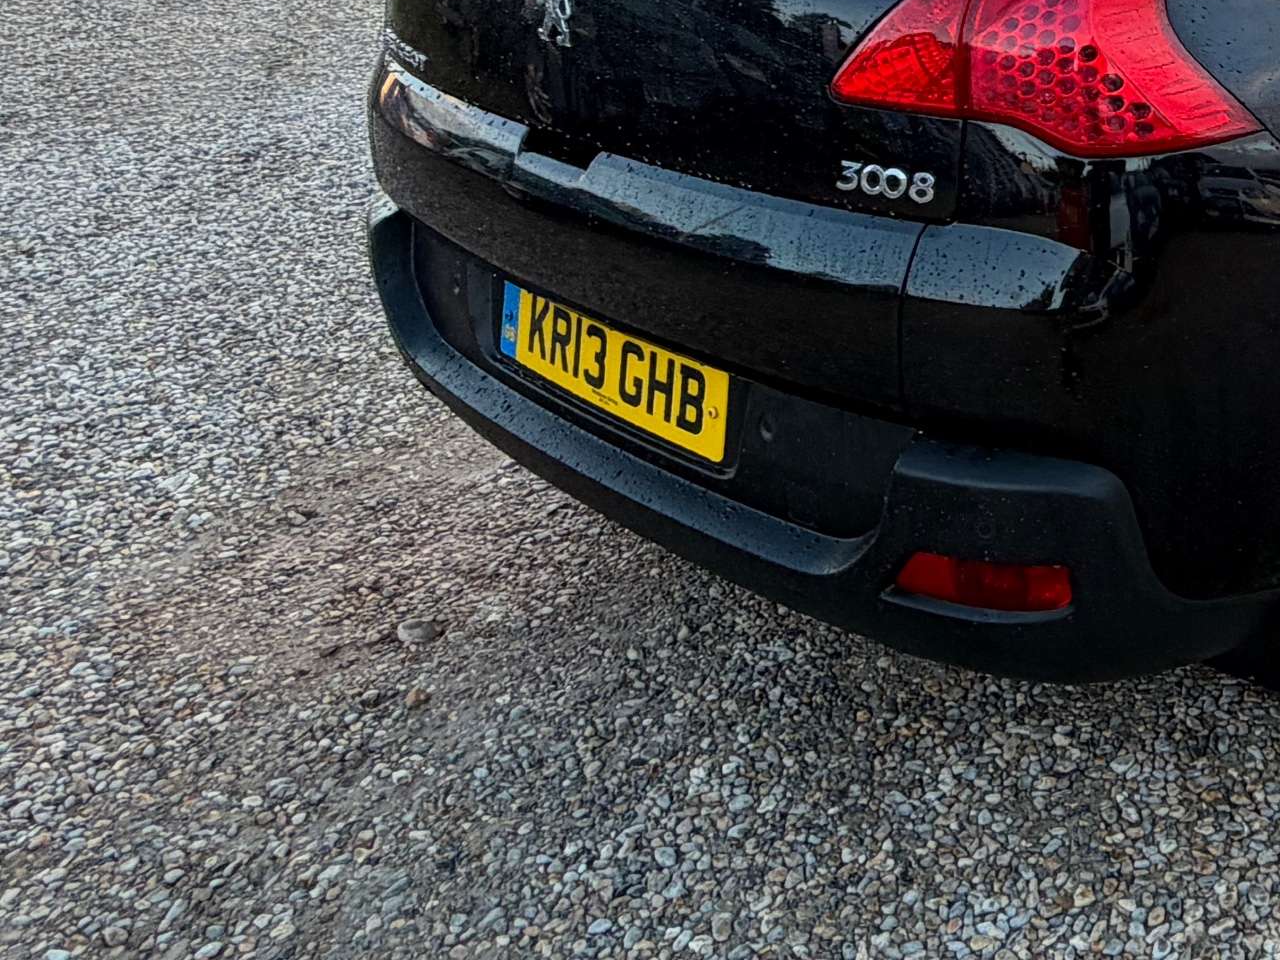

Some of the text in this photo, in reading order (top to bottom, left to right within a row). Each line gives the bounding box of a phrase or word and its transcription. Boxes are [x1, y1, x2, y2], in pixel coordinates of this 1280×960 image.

[835, 159, 936, 204] 3008
[528, 291, 706, 435] KR13 GHB
